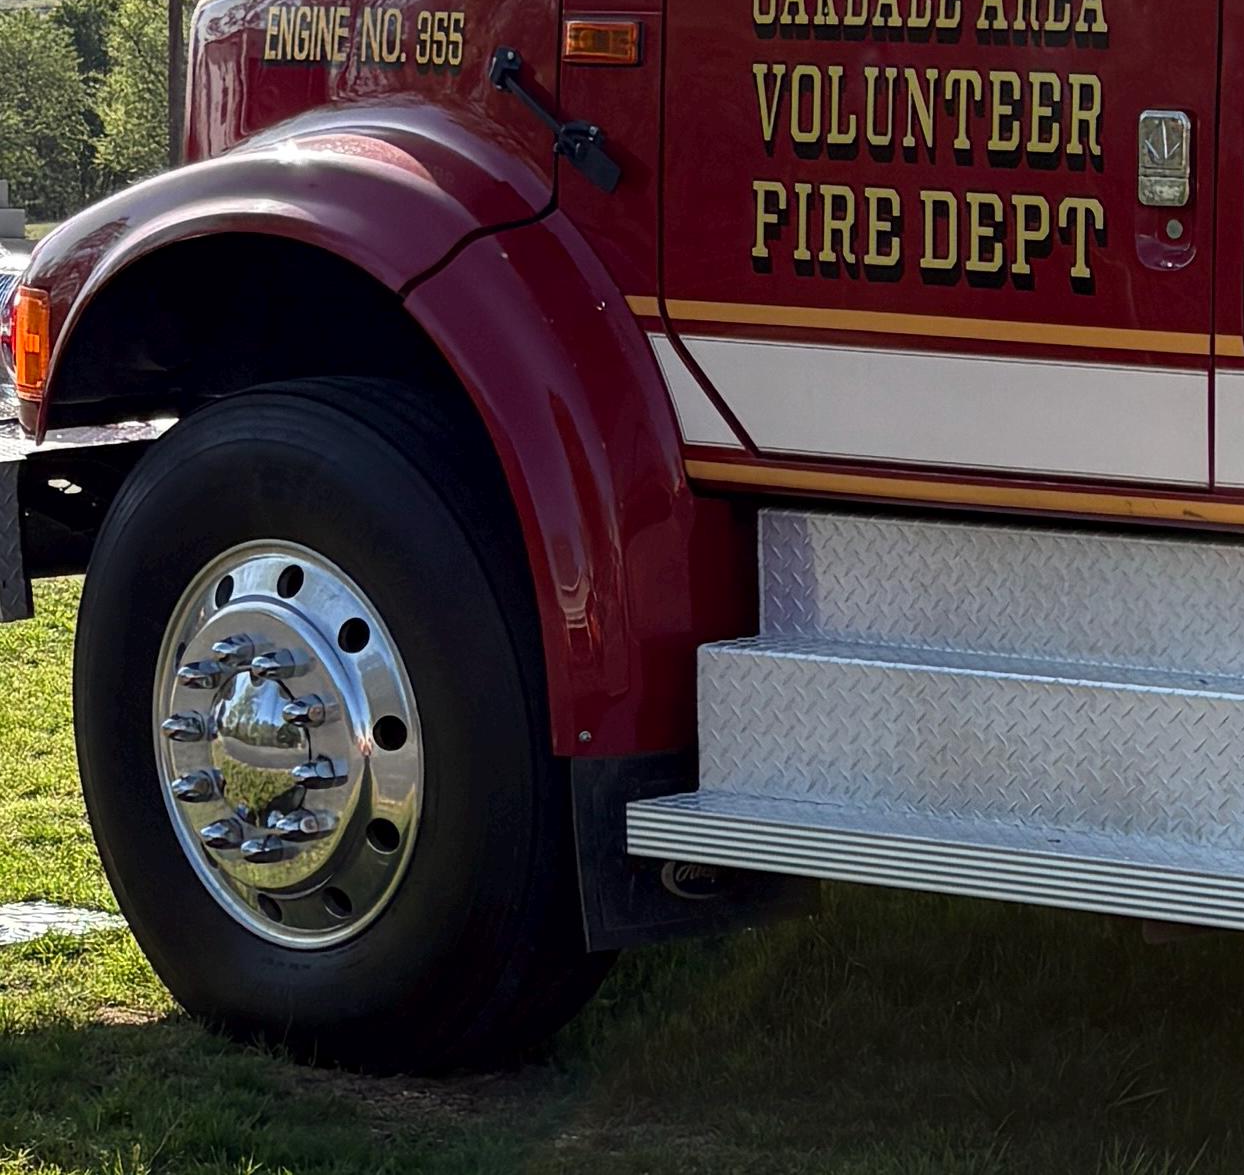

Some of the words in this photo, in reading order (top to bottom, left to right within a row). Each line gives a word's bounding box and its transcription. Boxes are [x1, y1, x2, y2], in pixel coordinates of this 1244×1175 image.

[263, 6, 349, 63] ENGINE
[360, 8, 407, 64] NO.
[415, 10, 466, 67] 355
[751, 63, 1101, 156] VOLUNTEER
[751, 180, 901, 267] FIRE
[919, 189, 1105, 279] DEPT
